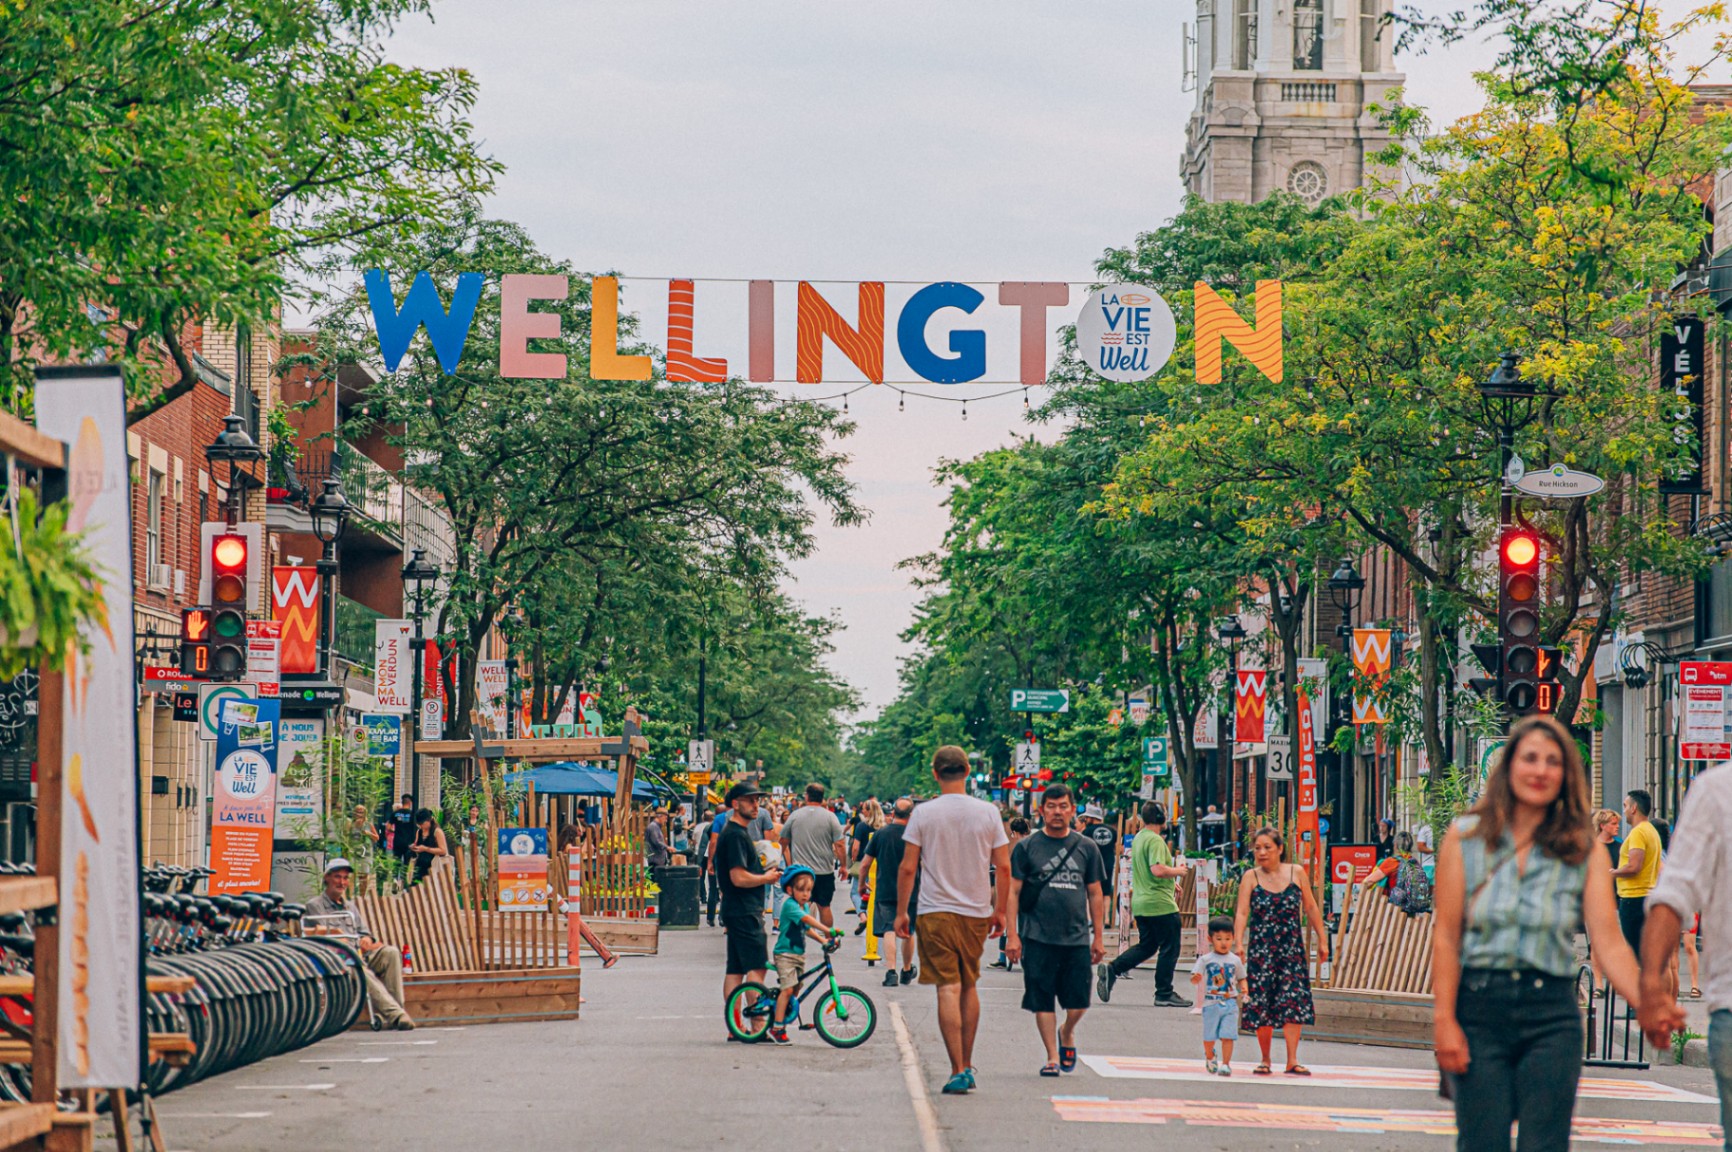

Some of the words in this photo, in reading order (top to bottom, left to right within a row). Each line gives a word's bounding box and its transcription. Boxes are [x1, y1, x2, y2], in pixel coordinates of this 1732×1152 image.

[1101, 293, 1119, 305] LA
[1101, 306, 1151, 332] VIE
[1126, 333, 1150, 345] EST
[1100, 345, 1150, 371] Well
[1539, 480, 1552, 488] Rue
[1552, 480, 1579, 488] Hickson
[387, 638, 398, 687] VERDUN
[377, 658, 388, 687] MON
[165, 681, 182, 691] fido
[377, 687, 396, 696] MA
[177, 695, 193, 708] Le
[377, 696, 409, 706] WELL
[1148, 740, 1163, 759] P
[233, 762, 258, 775] VIE
[232, 780, 256, 794] Well
[219, 811, 234, 822] LA
[236, 812, 266, 823] WELL
